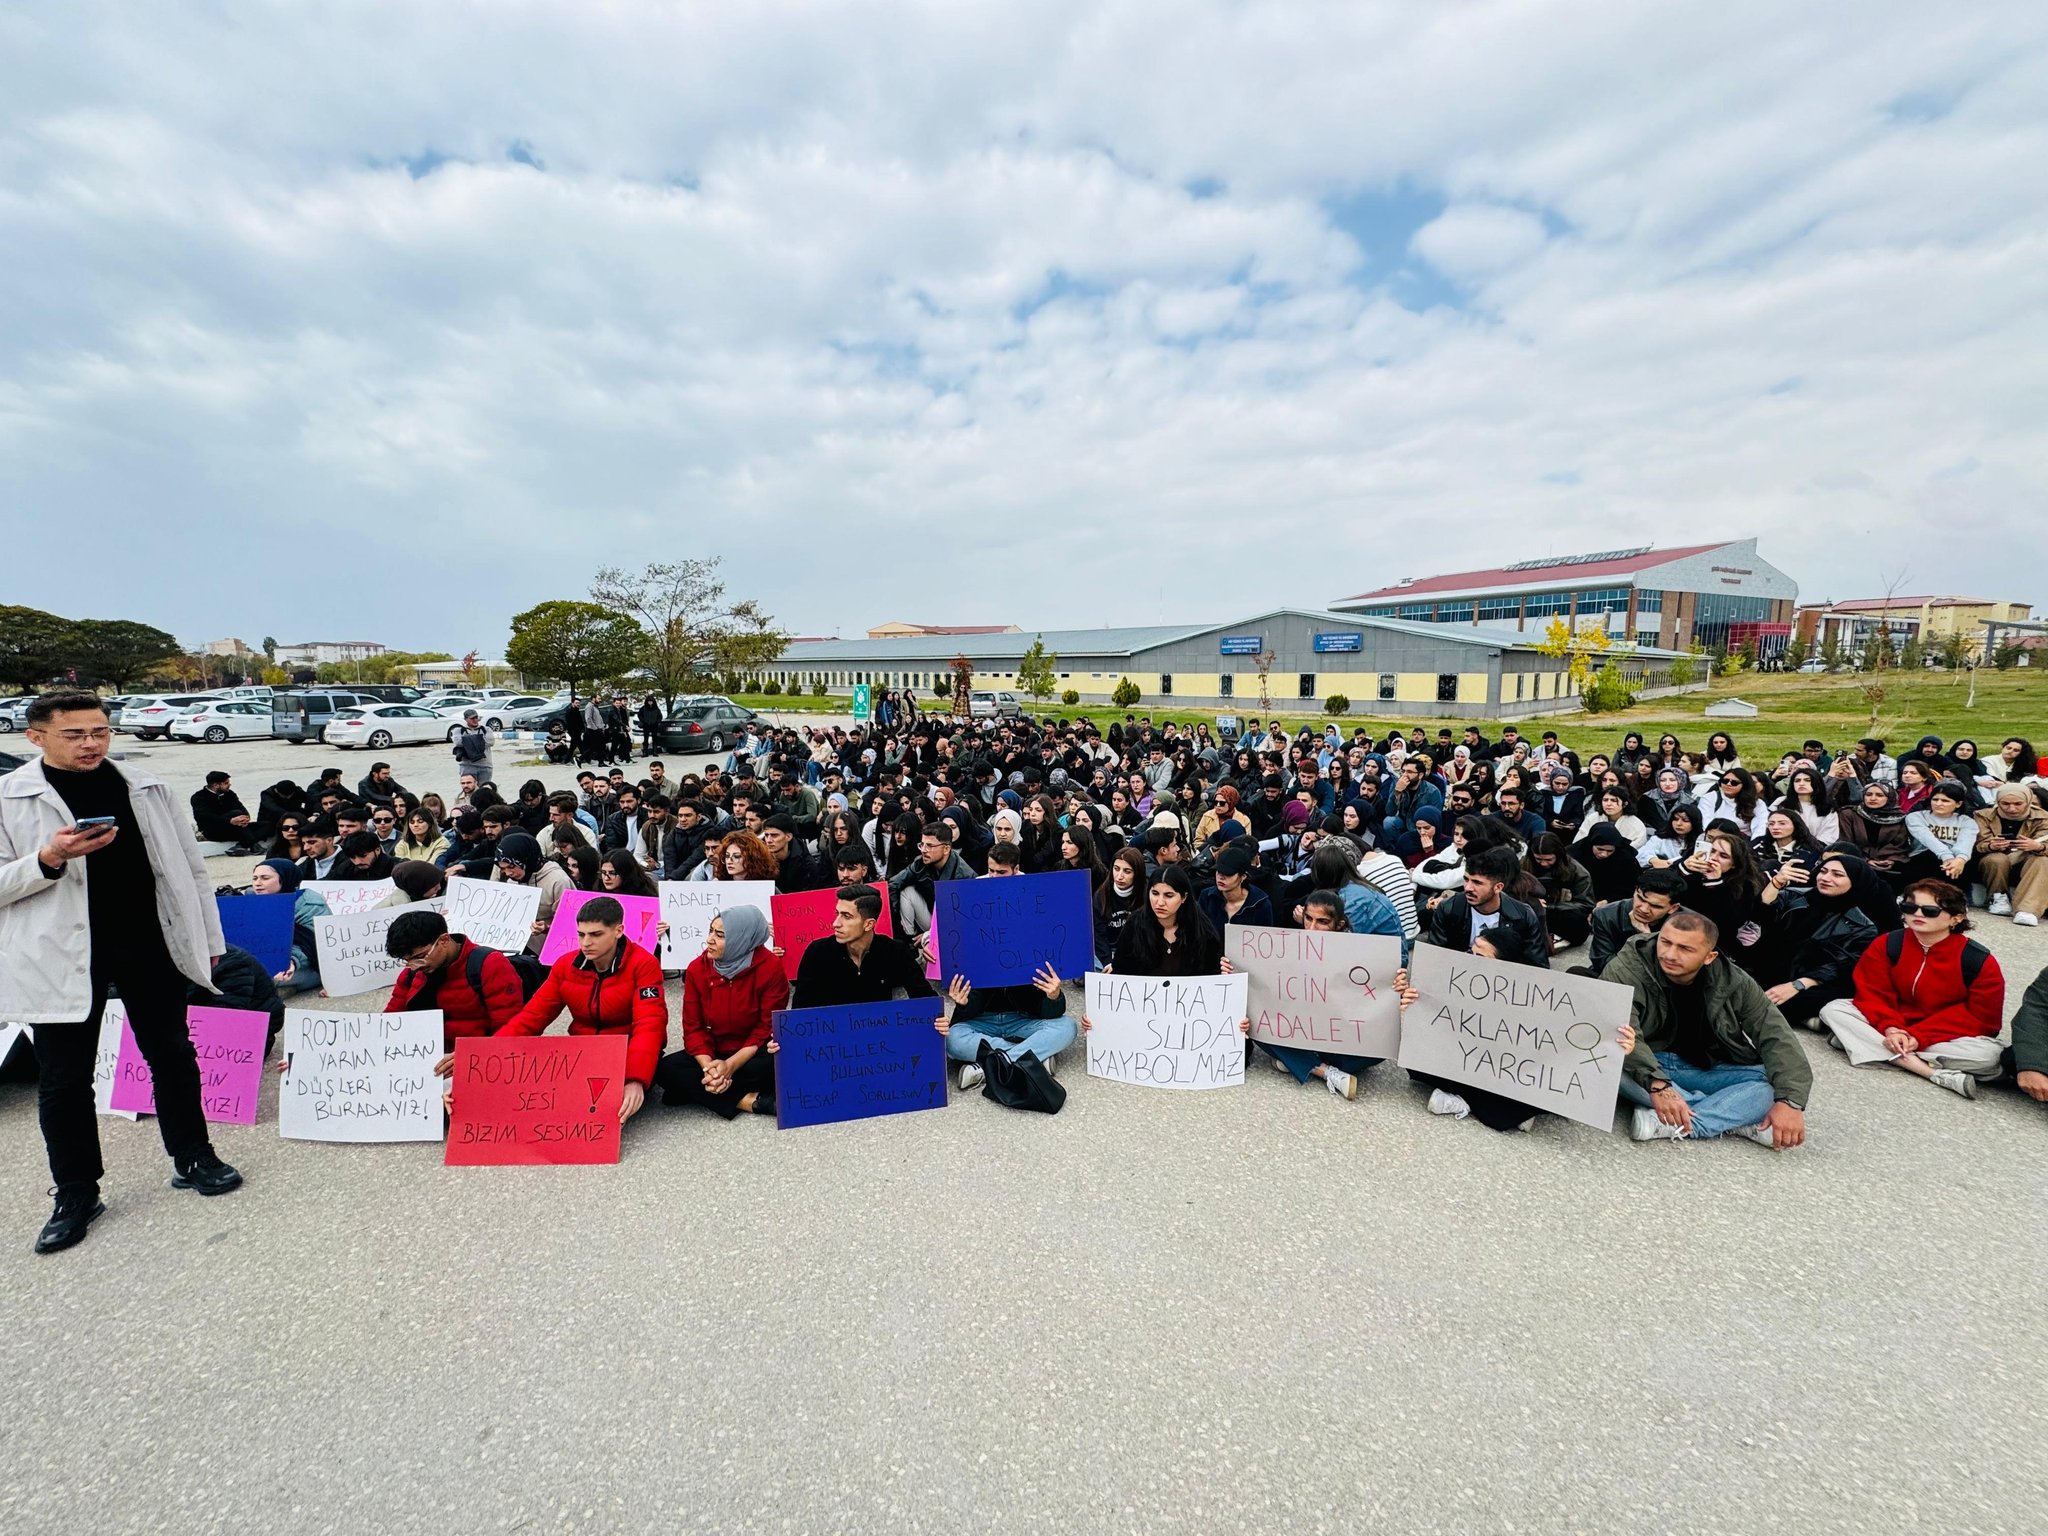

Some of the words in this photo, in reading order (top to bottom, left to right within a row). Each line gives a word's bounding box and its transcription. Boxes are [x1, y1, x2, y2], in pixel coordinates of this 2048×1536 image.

[668, 892, 722, 909] ADALET
[324, 924, 352, 947] BU
[979, 927, 1009, 947] NE
[336, 943, 386, 961] SUSKU
[351, 959, 402, 977] DİREN
[1098, 980, 1232, 1018] HAKİKAT
[1448, 966, 1576, 1016] KORUMA
[778, 1013, 836, 1037] ROJİN
[1145, 1016, 1237, 1051] SUDA
[1256, 1010, 1365, 1043] ADALET
[1431, 1005, 1558, 1054] AKLAMA
[319, 1048, 376, 1072] YARIM
[384, 1040, 435, 1062] KALAN
[805, 1040, 897, 1064] KATİLLER
[1091, 1046, 1245, 1083] KAYBOLMAZ
[1458, 1041, 1584, 1100] YARGILA
[298, 1076, 372, 1101] DÜŞLERİ
[389, 1074, 424, 1097] İÇİN
[512, 1088, 556, 1111] SESİ
[786, 1087, 840, 1110] HESAP
[314, 1099, 428, 1121] BURADAYIZ!
[457, 1122, 517, 1144] BİZİM
[525, 1121, 606, 1144] SESİMİZ
